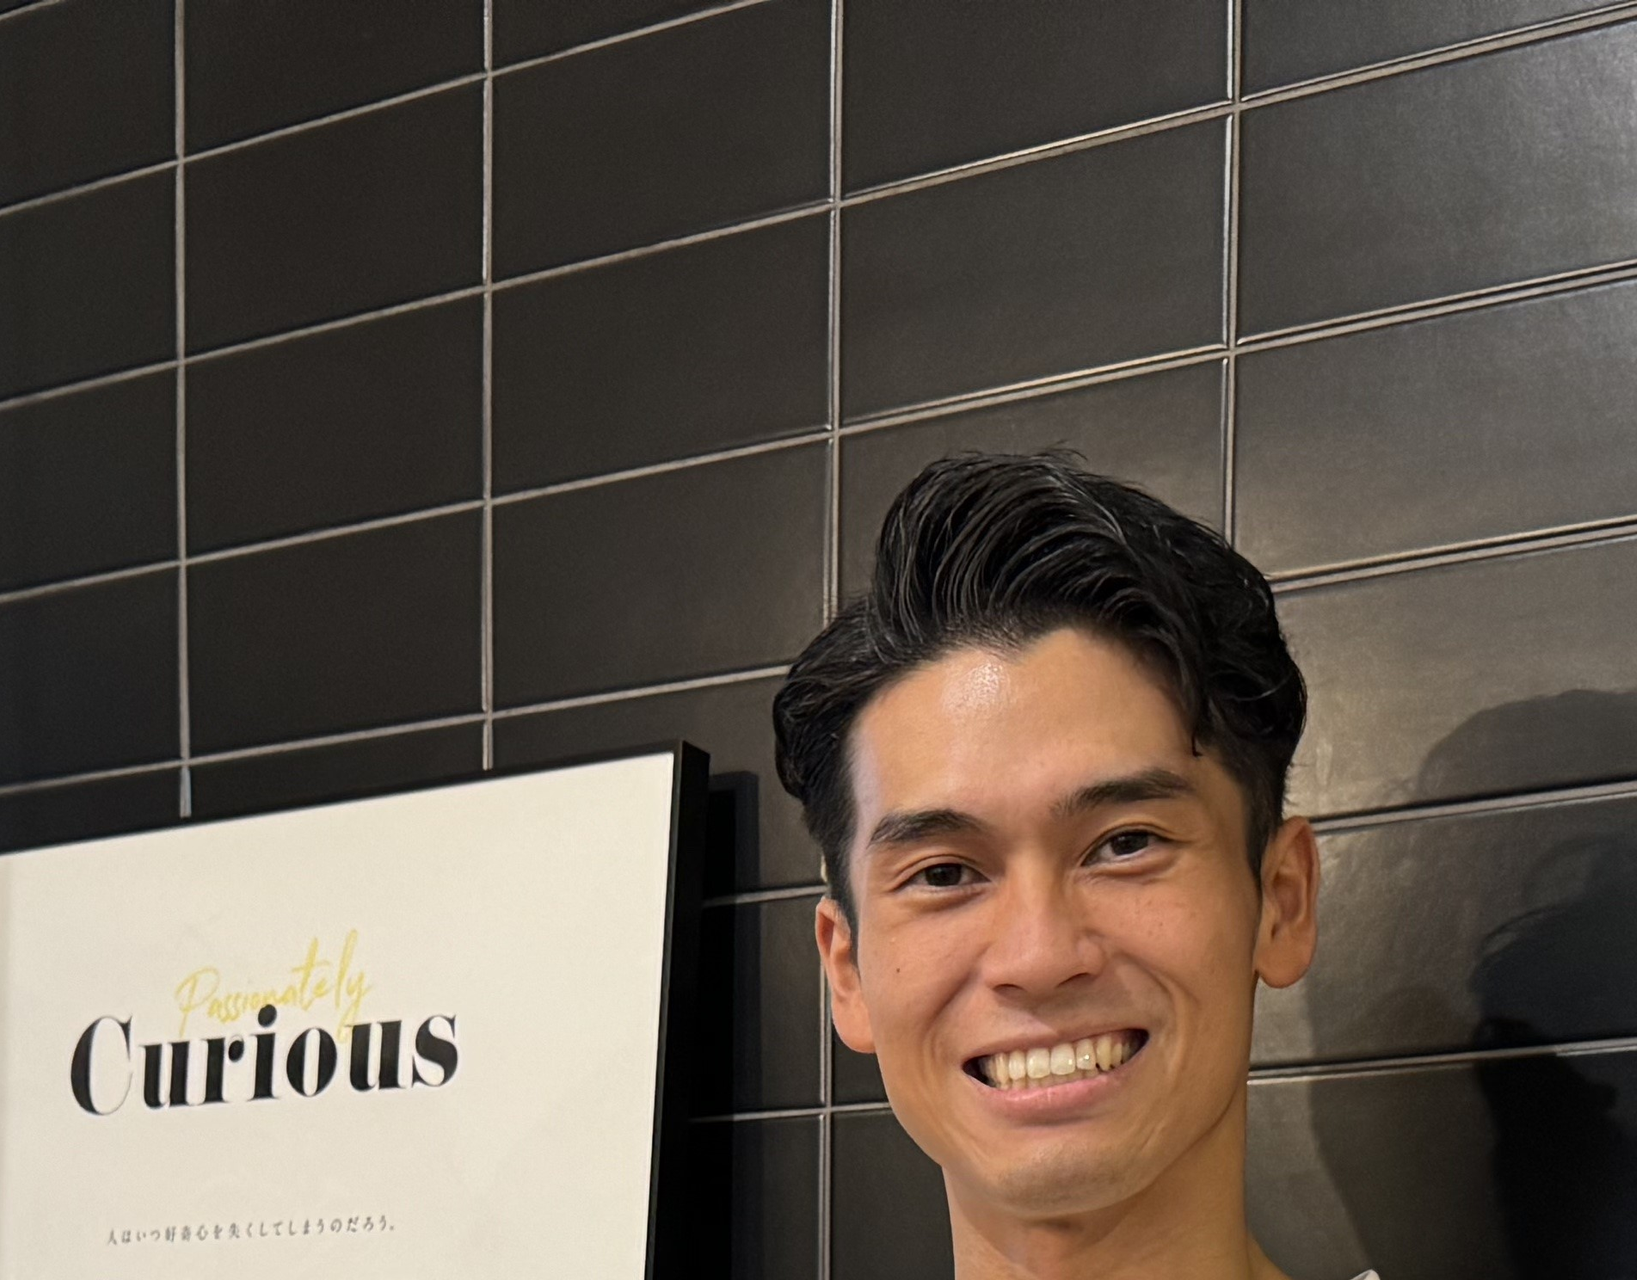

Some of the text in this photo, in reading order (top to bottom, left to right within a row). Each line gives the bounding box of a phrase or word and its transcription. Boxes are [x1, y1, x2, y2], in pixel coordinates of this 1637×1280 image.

[174, 928, 374, 1042] Passionately
[70, 1003, 460, 1117] Curious
[107, 1214, 395, 1246] 人はいつ好奇心を失くしてしまうのだろう。
